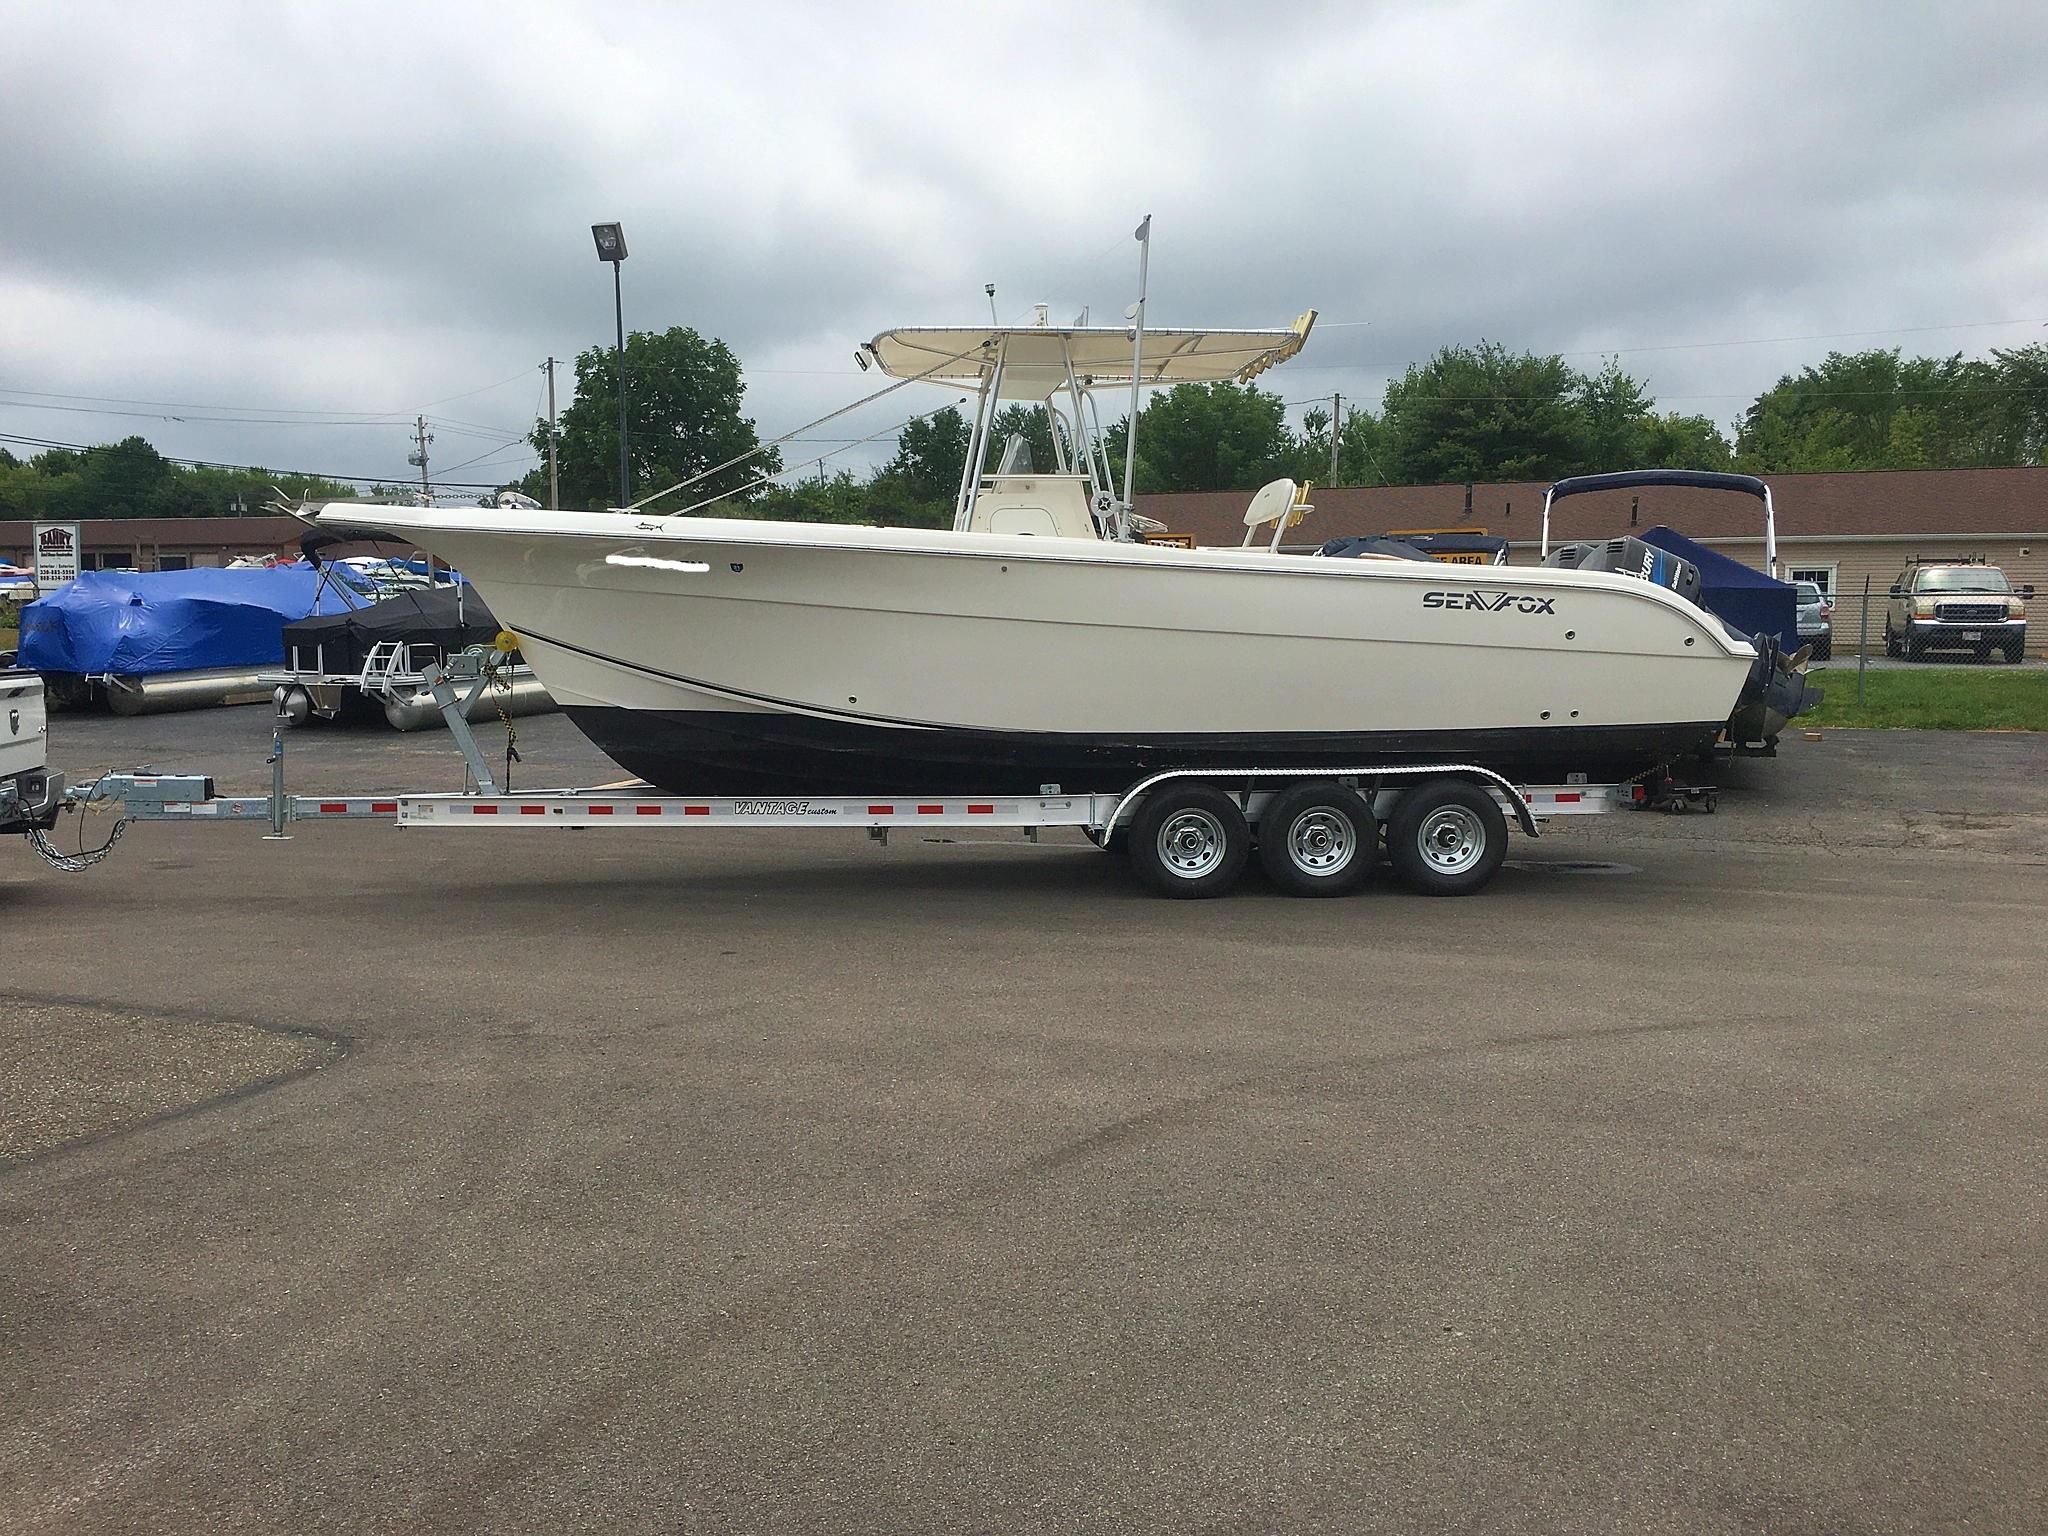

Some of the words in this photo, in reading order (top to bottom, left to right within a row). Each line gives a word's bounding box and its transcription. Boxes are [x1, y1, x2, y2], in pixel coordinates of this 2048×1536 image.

[1452, 556, 1482, 565] AREA
[735, 801, 810, 815] VANTAGE
[807, 807, 838, 815] custom
